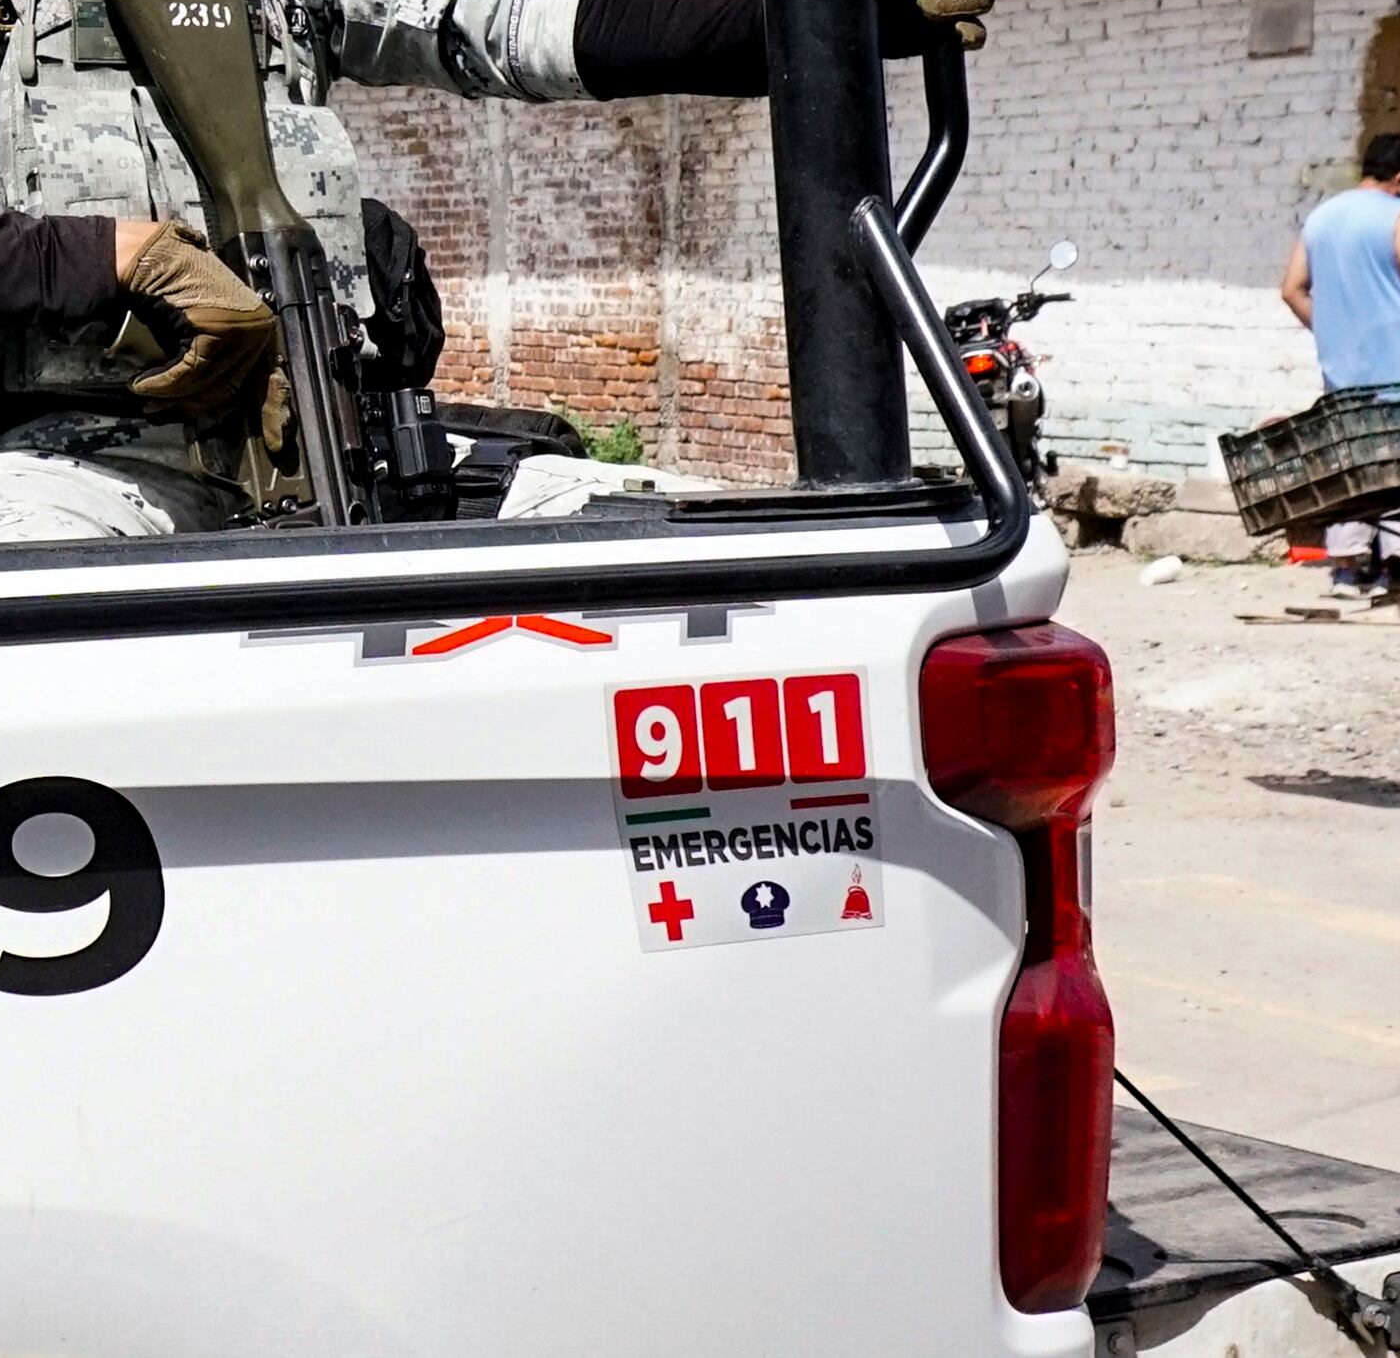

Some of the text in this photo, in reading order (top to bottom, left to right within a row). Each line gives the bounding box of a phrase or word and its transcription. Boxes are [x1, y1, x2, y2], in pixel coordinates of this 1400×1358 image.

[169, 3, 231, 28] 239
[634, 690, 840, 782] 911
[629, 816, 874, 873] EMERGENCIAS
